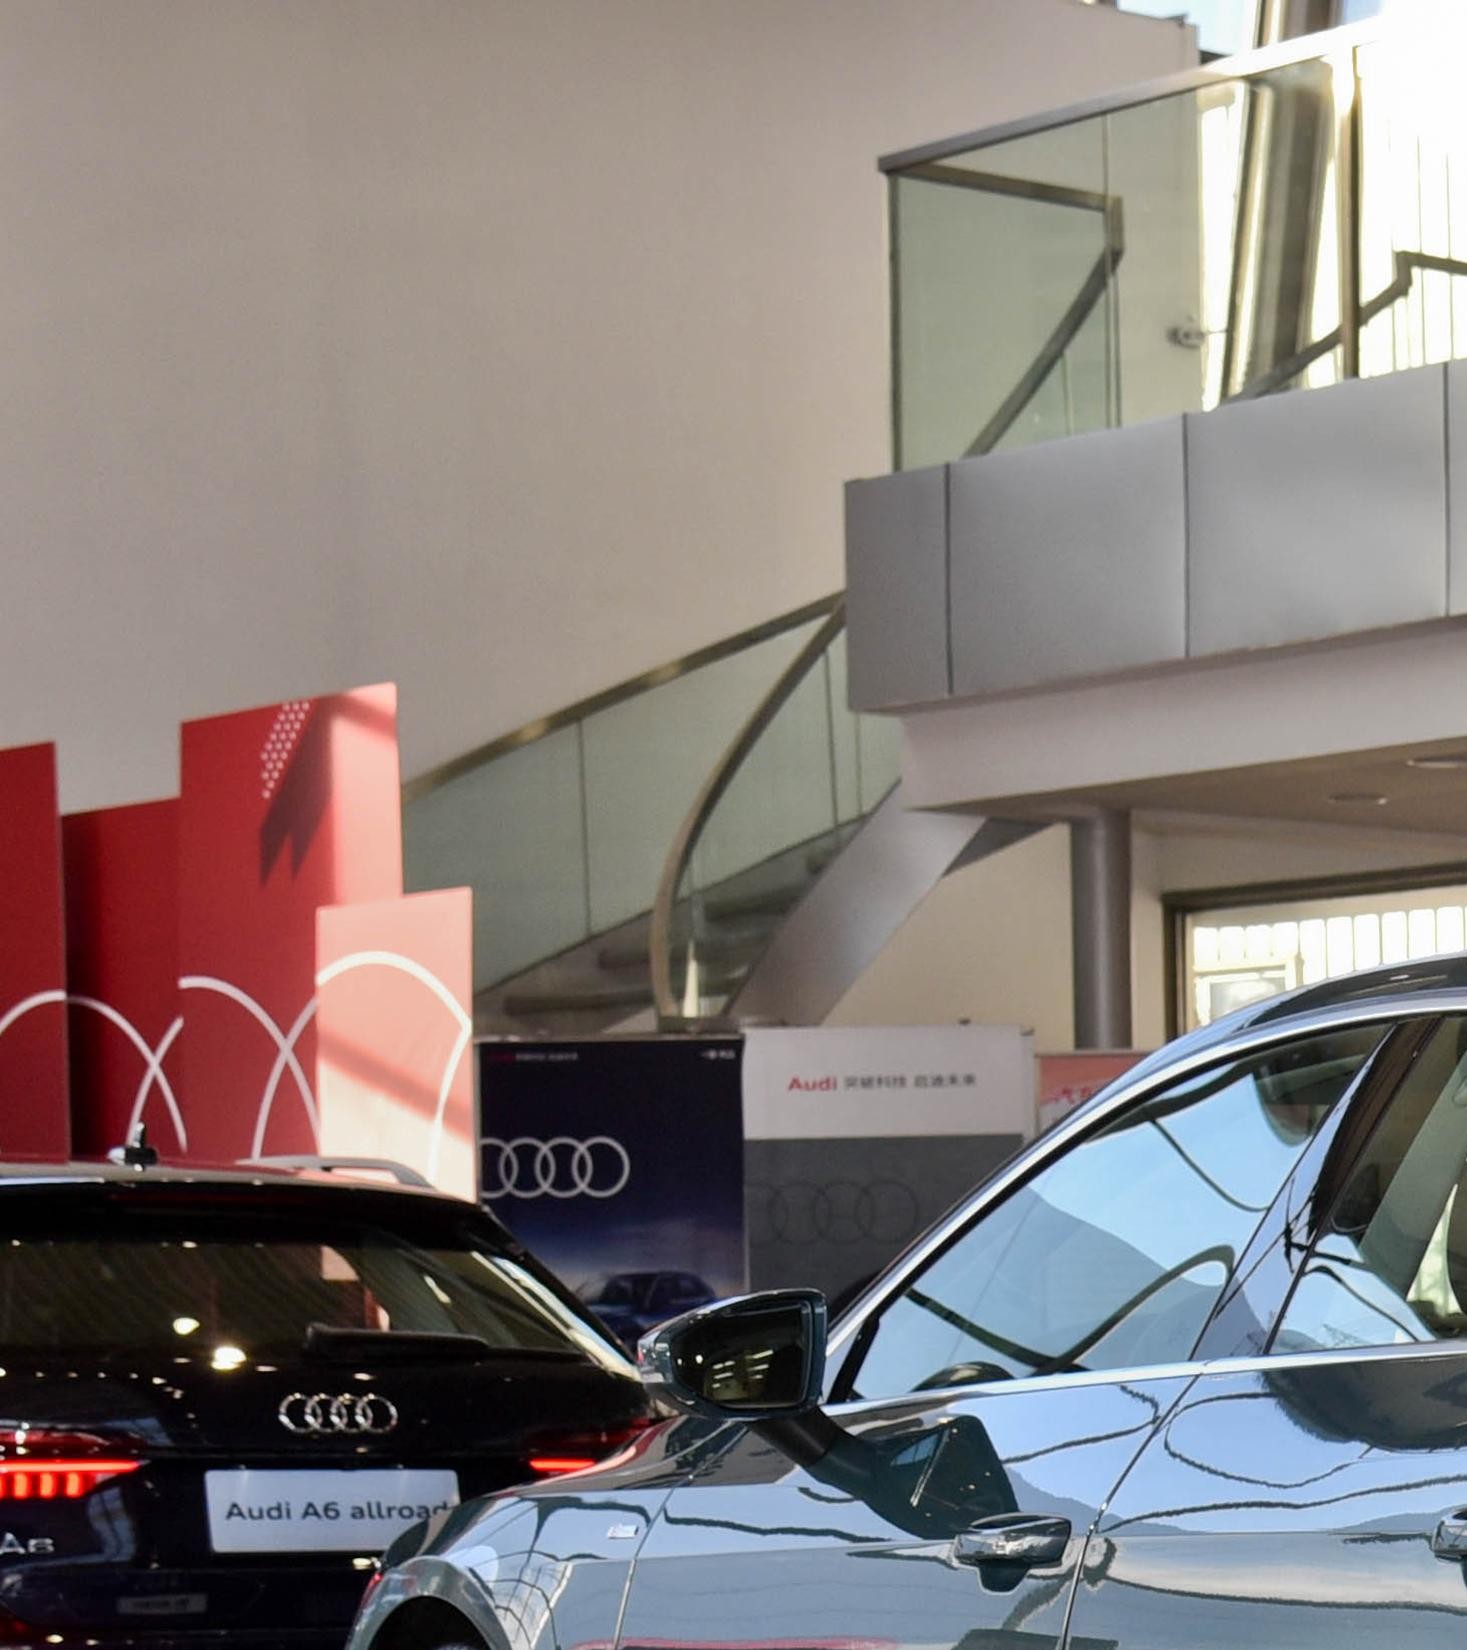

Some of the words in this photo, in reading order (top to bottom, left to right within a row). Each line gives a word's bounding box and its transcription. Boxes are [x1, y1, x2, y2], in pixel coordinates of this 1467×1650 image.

[788, 1076, 837, 1092] Audi
[225, 1500, 292, 1521] Audi
[302, 1501, 340, 1520] A6
